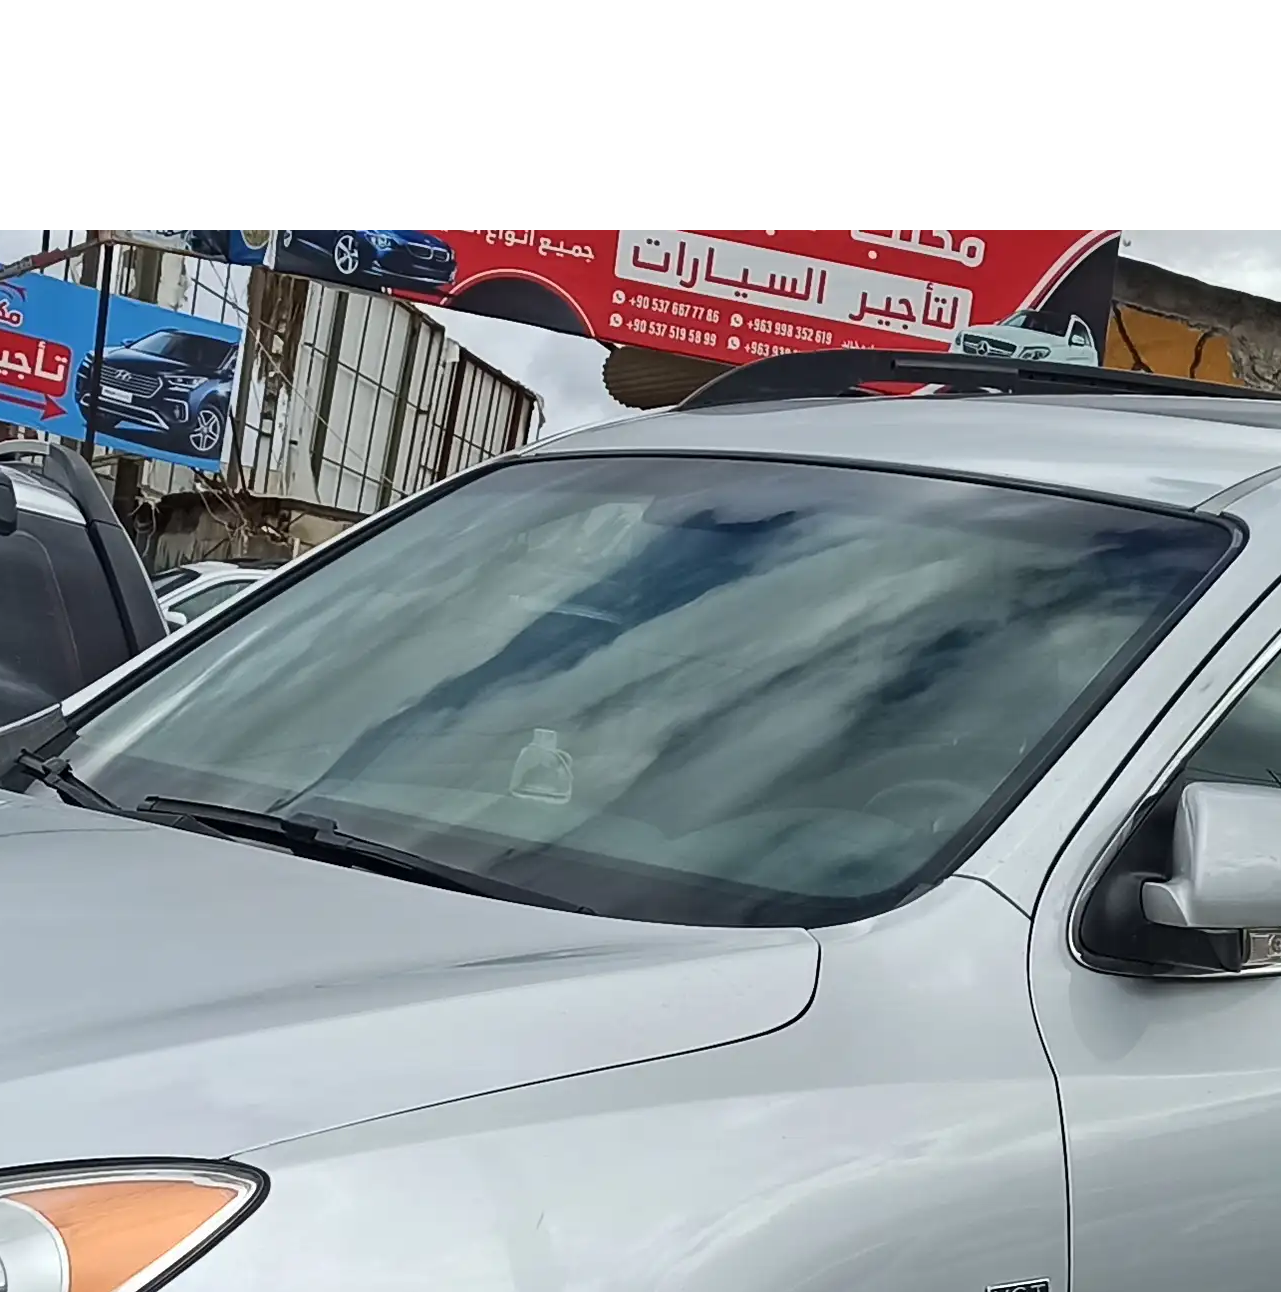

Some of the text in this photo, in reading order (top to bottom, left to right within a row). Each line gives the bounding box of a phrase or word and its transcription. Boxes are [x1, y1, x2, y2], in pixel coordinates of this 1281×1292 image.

[538, 236, 595, 263] جميع
[632, 238, 959, 331] لتأجير السيارات
[651, 298, 671, 314] 537
[693, 305, 705, 320] 77
[648, 322, 668, 337] 537
[669, 325, 687, 341] 519
[688, 329, 703, 344] 58
[704, 332, 717, 347] 99
